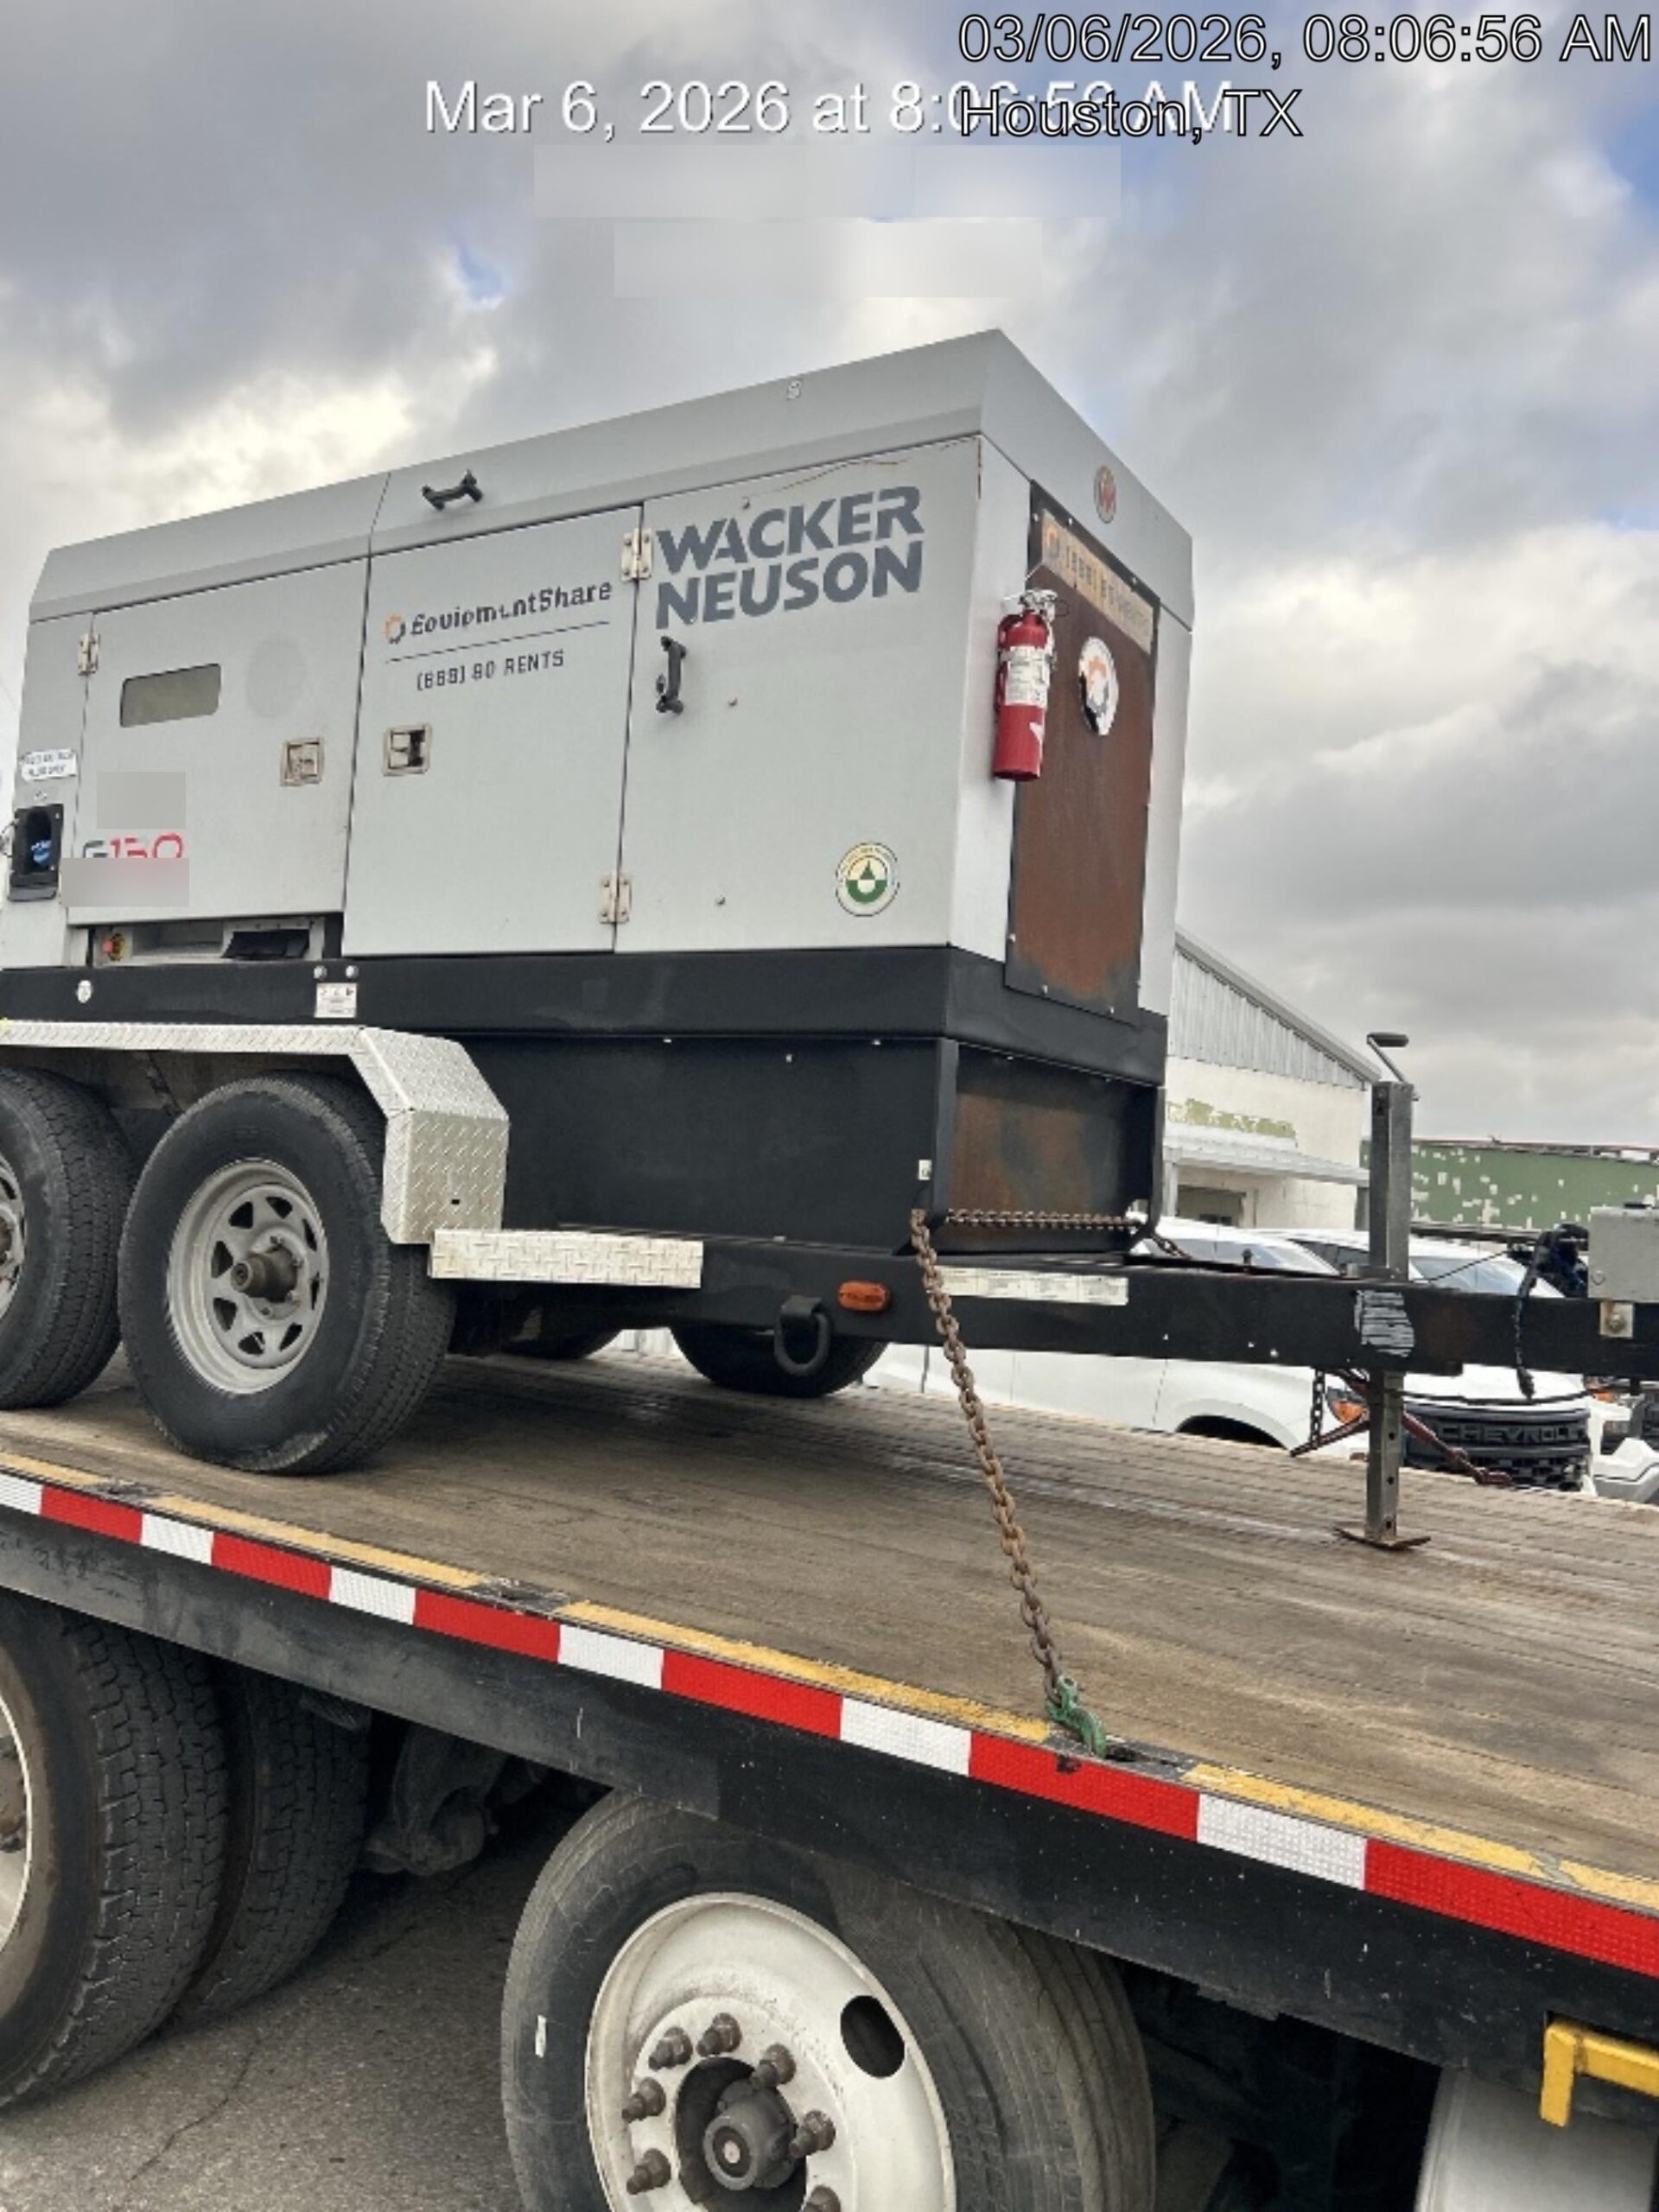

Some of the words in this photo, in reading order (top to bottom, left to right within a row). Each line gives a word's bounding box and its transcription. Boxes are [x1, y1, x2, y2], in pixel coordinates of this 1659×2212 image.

[655, 486, 925, 575] WACKER
[655, 540, 923, 630] NEUSON
[504, 649, 564, 677] RENTS
